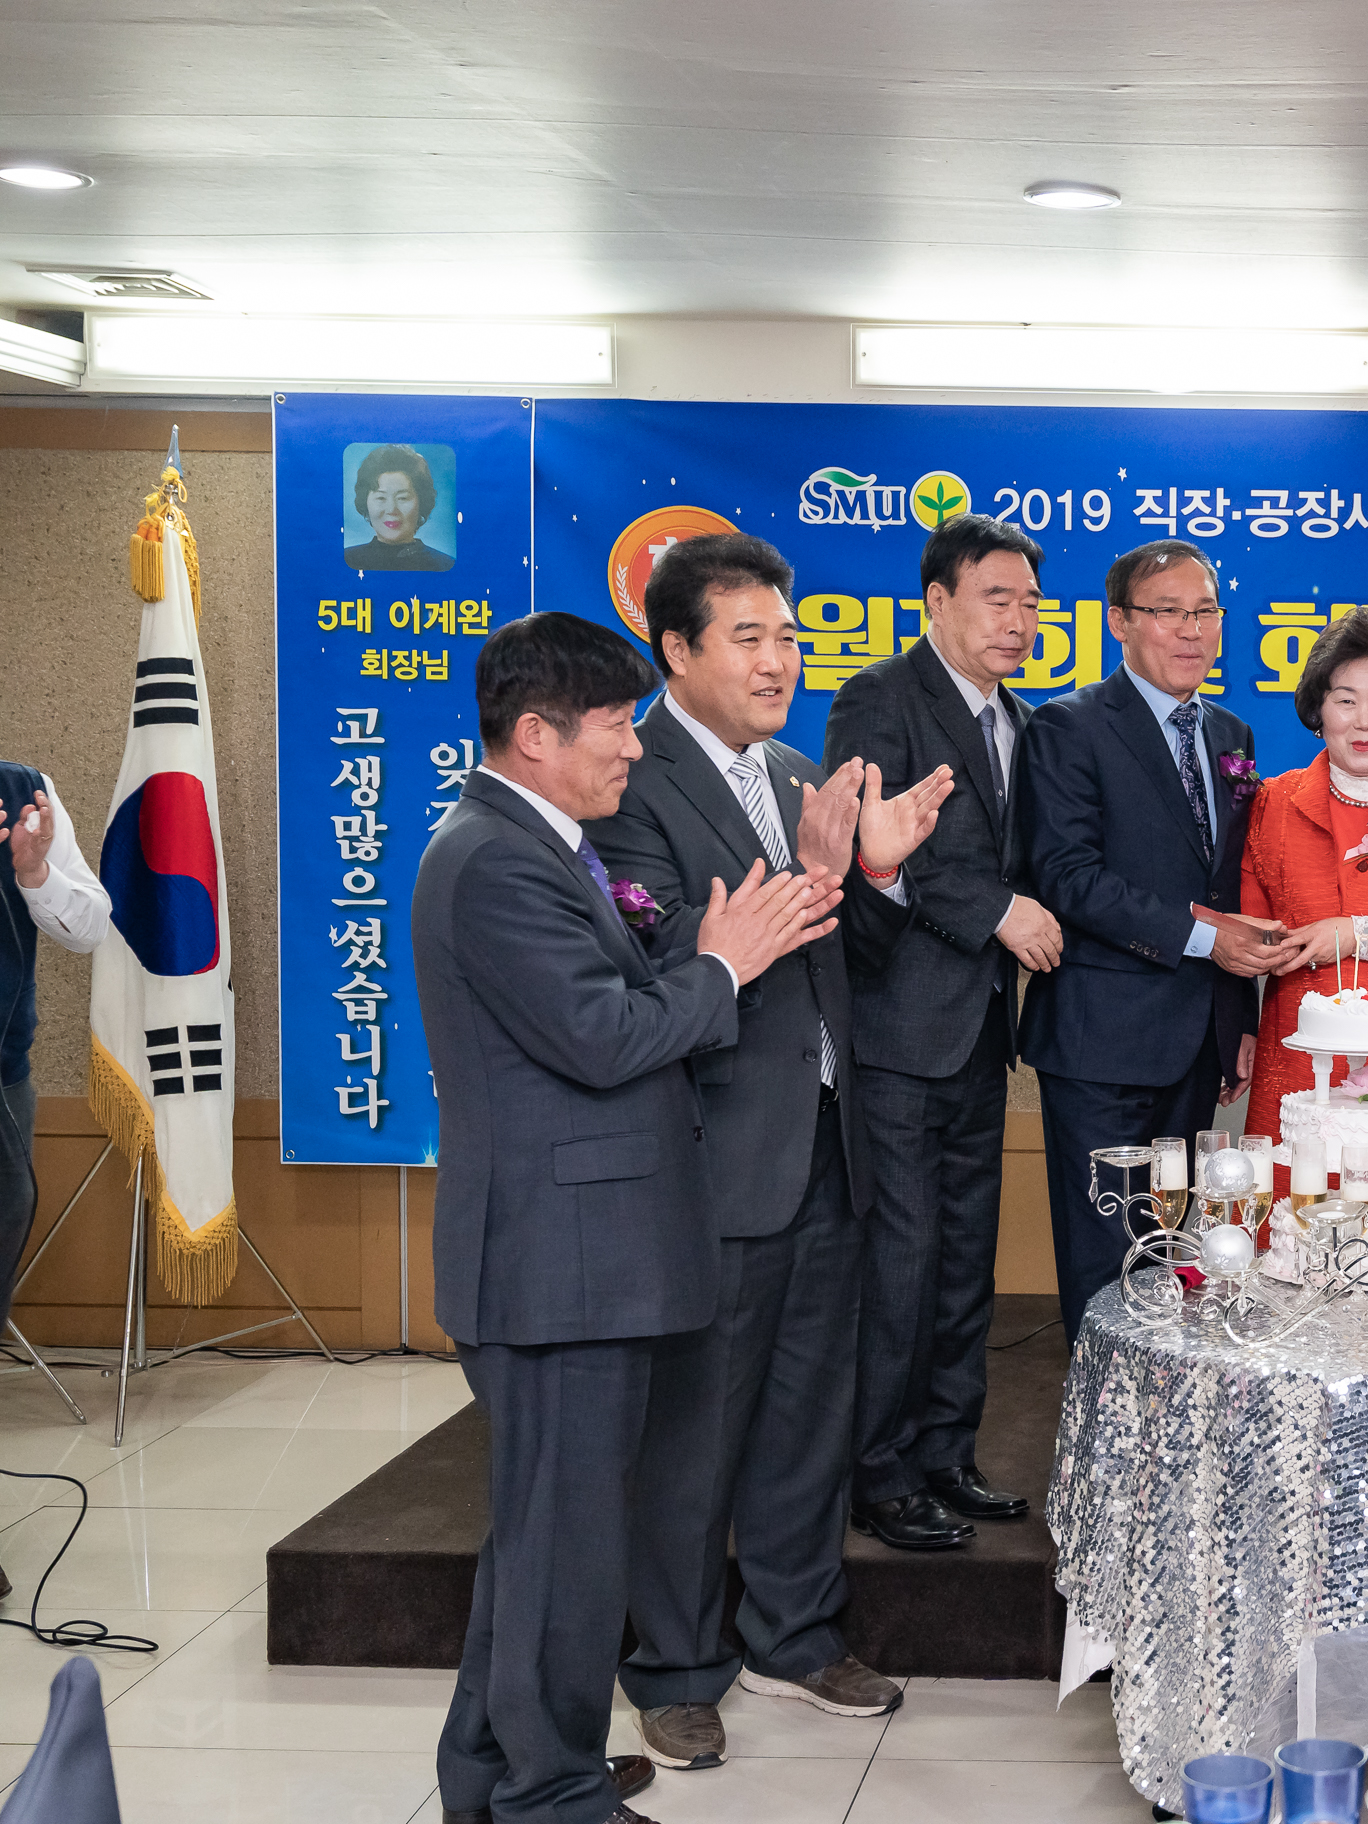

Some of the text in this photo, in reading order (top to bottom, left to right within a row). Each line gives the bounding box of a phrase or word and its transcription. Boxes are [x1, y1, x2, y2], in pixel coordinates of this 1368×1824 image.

[800, 474, 906, 525] SMU
[994, 487, 1111, 533] 2019
[318, 598, 492, 635] 5대 이계완
[360, 649, 448, 680] 회장님
